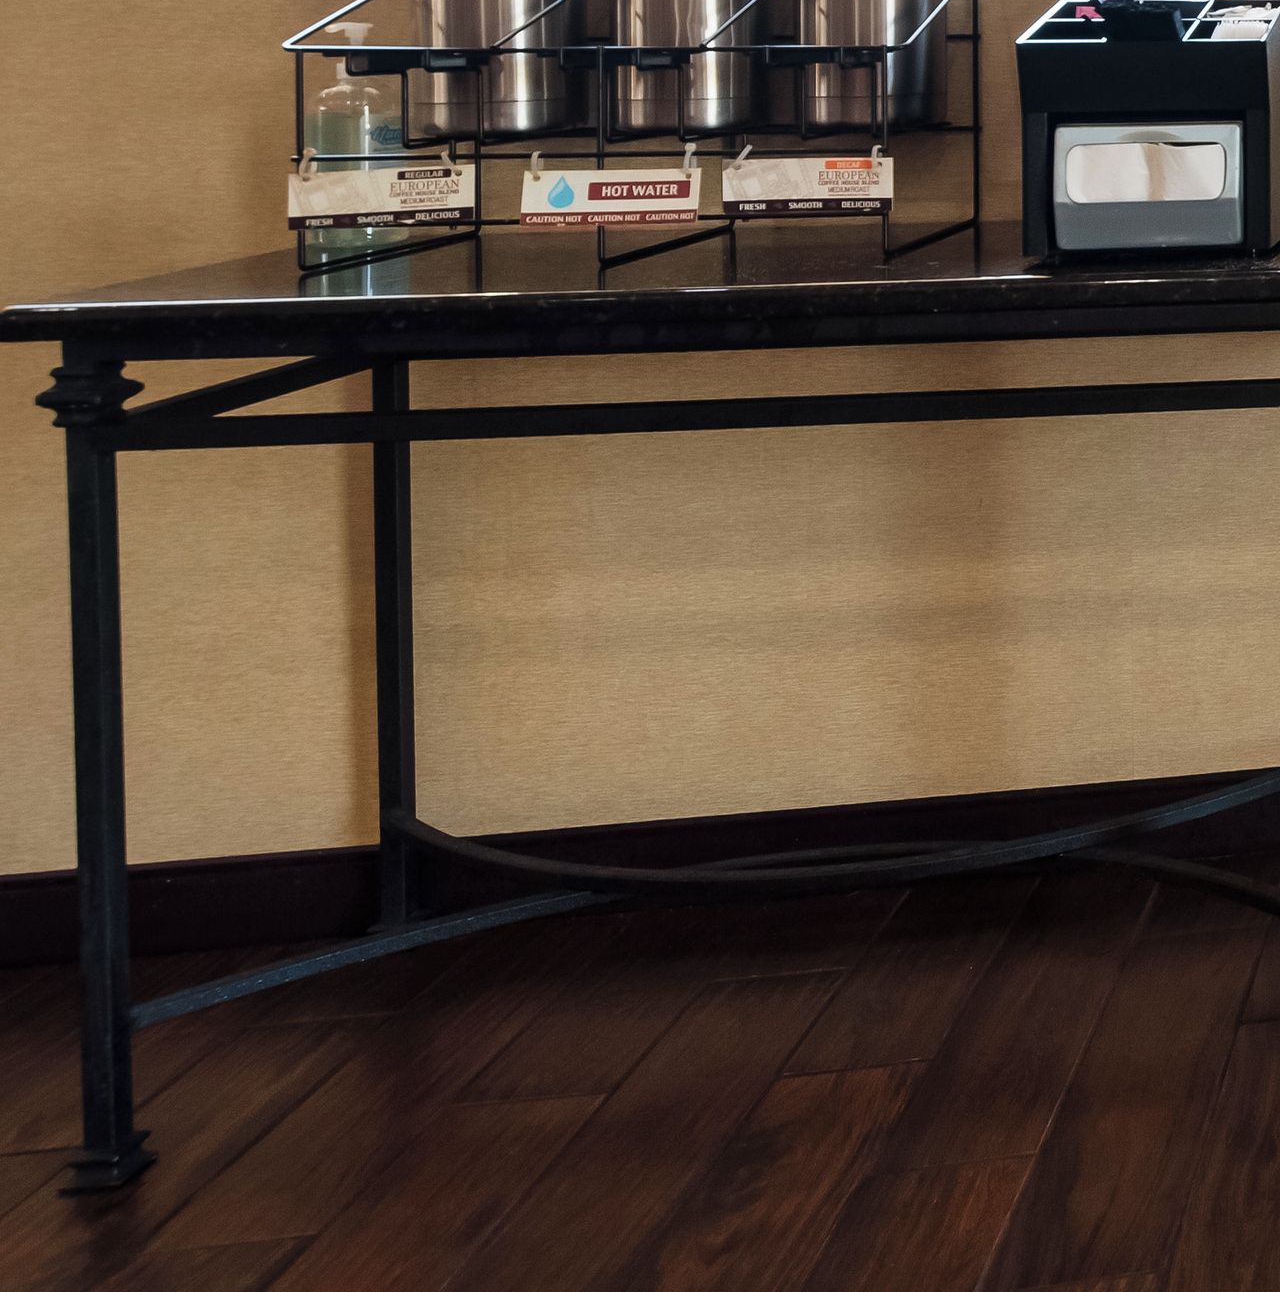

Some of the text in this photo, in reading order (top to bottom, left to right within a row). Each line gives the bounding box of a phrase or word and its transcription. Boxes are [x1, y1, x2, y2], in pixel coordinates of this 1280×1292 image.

[404, 170, 443, 179] REGULAR
[818, 171, 879, 181] EUROPEAN
[390, 179, 460, 192] EUROPEAN
[602, 184, 678, 197] HOT WATER
[739, 200, 881, 211] FRESH SMOOTH DELICIOUS
[306, 210, 460, 227] FRESH SMOOTH DELICIOUS
[526, 212, 694, 223] CAUTION HOT CAUTION HOT CAUTION HOT
